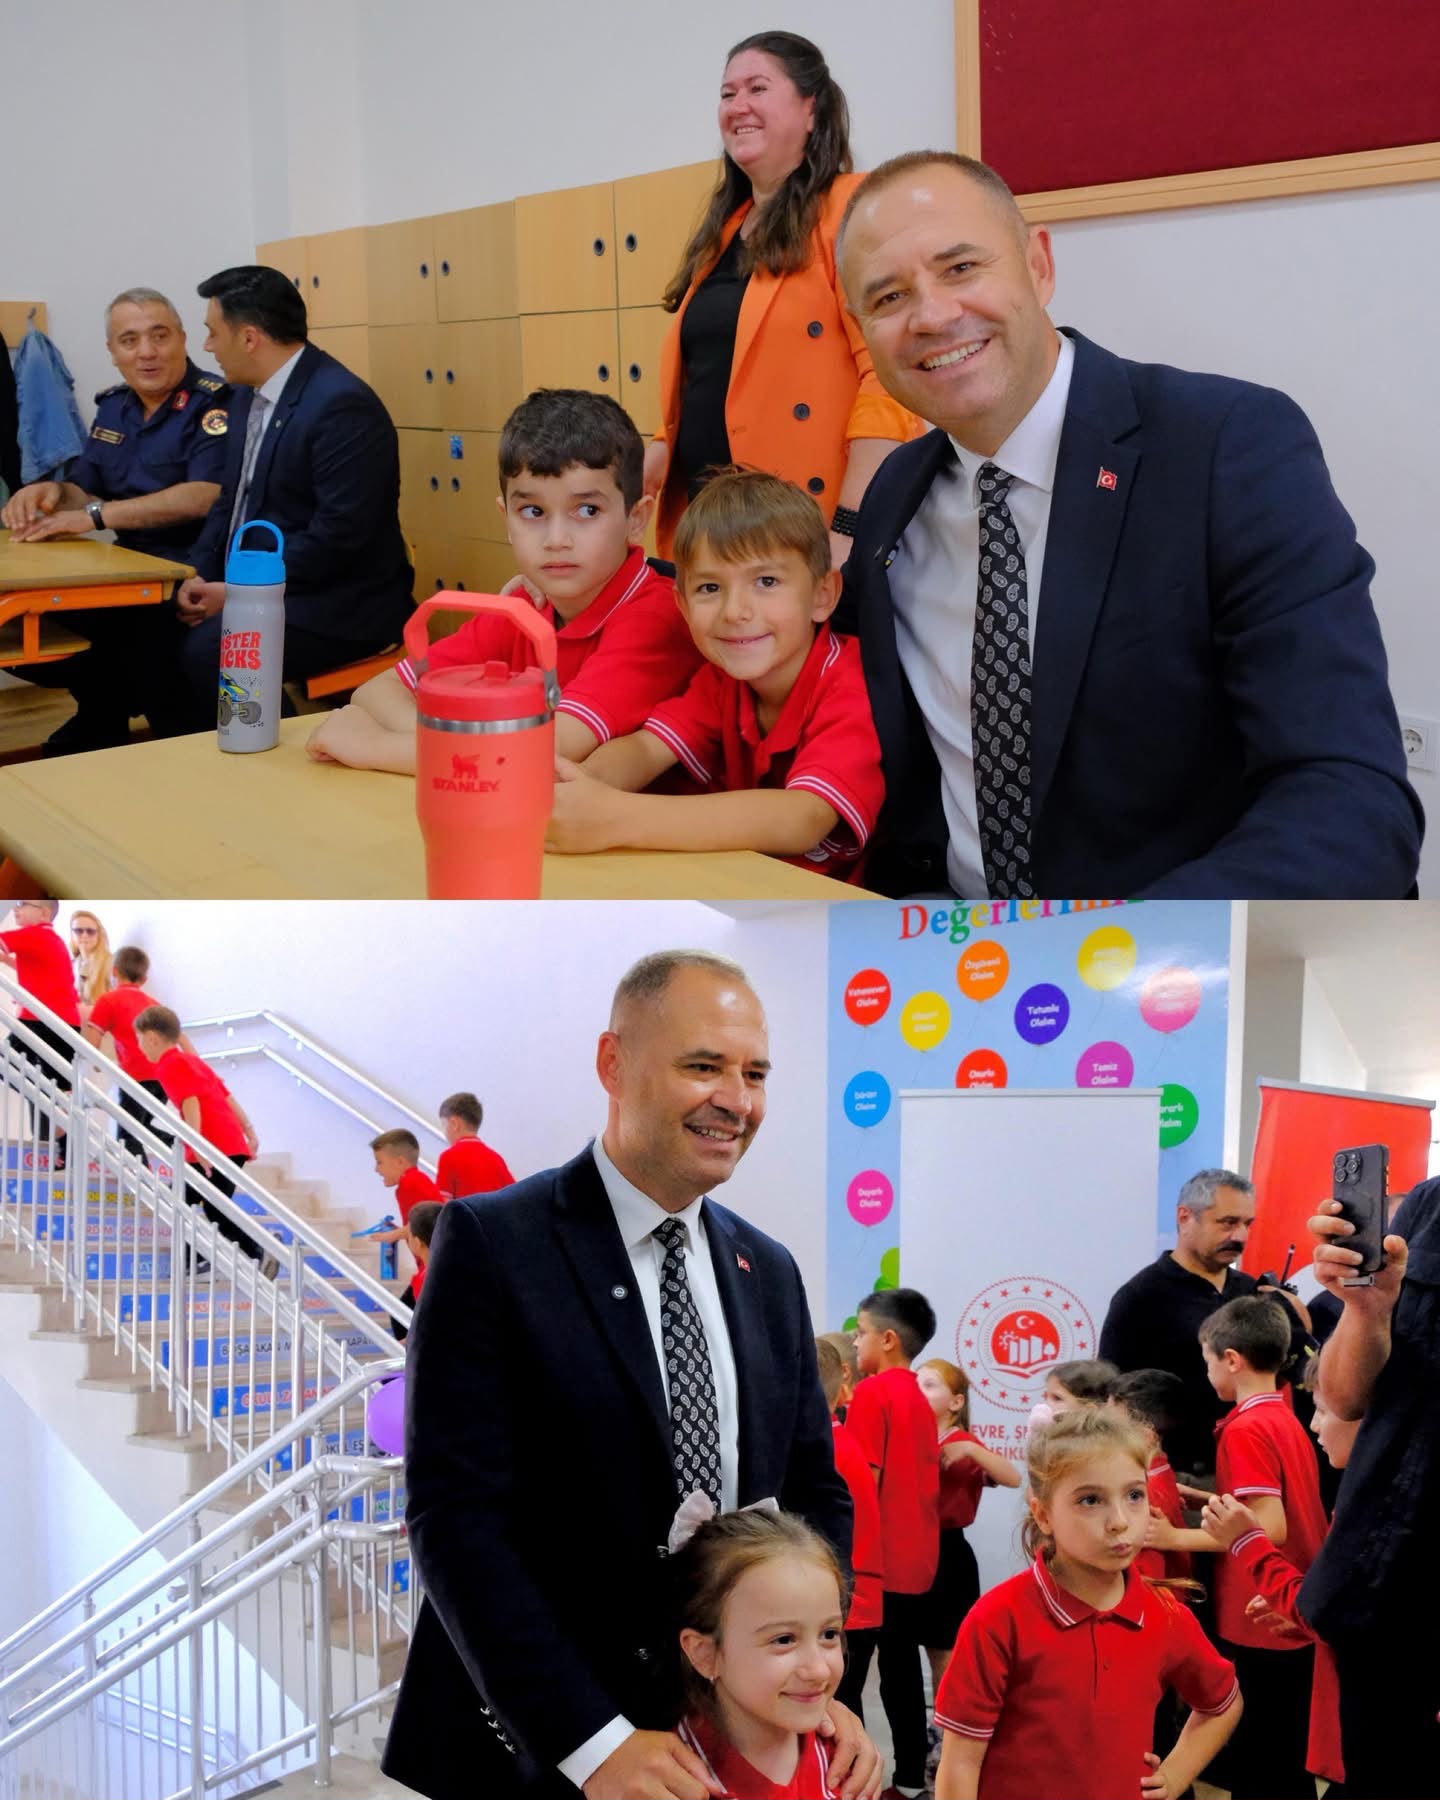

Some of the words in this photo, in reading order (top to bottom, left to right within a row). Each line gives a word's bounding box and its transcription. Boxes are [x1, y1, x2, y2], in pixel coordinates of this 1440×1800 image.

[219, 648, 262, 670] CKS
[432, 777, 501, 793] STANLEY
[898, 900, 1145, 944] Değerler
[970, 1424, 1010, 1440] EVRE,
